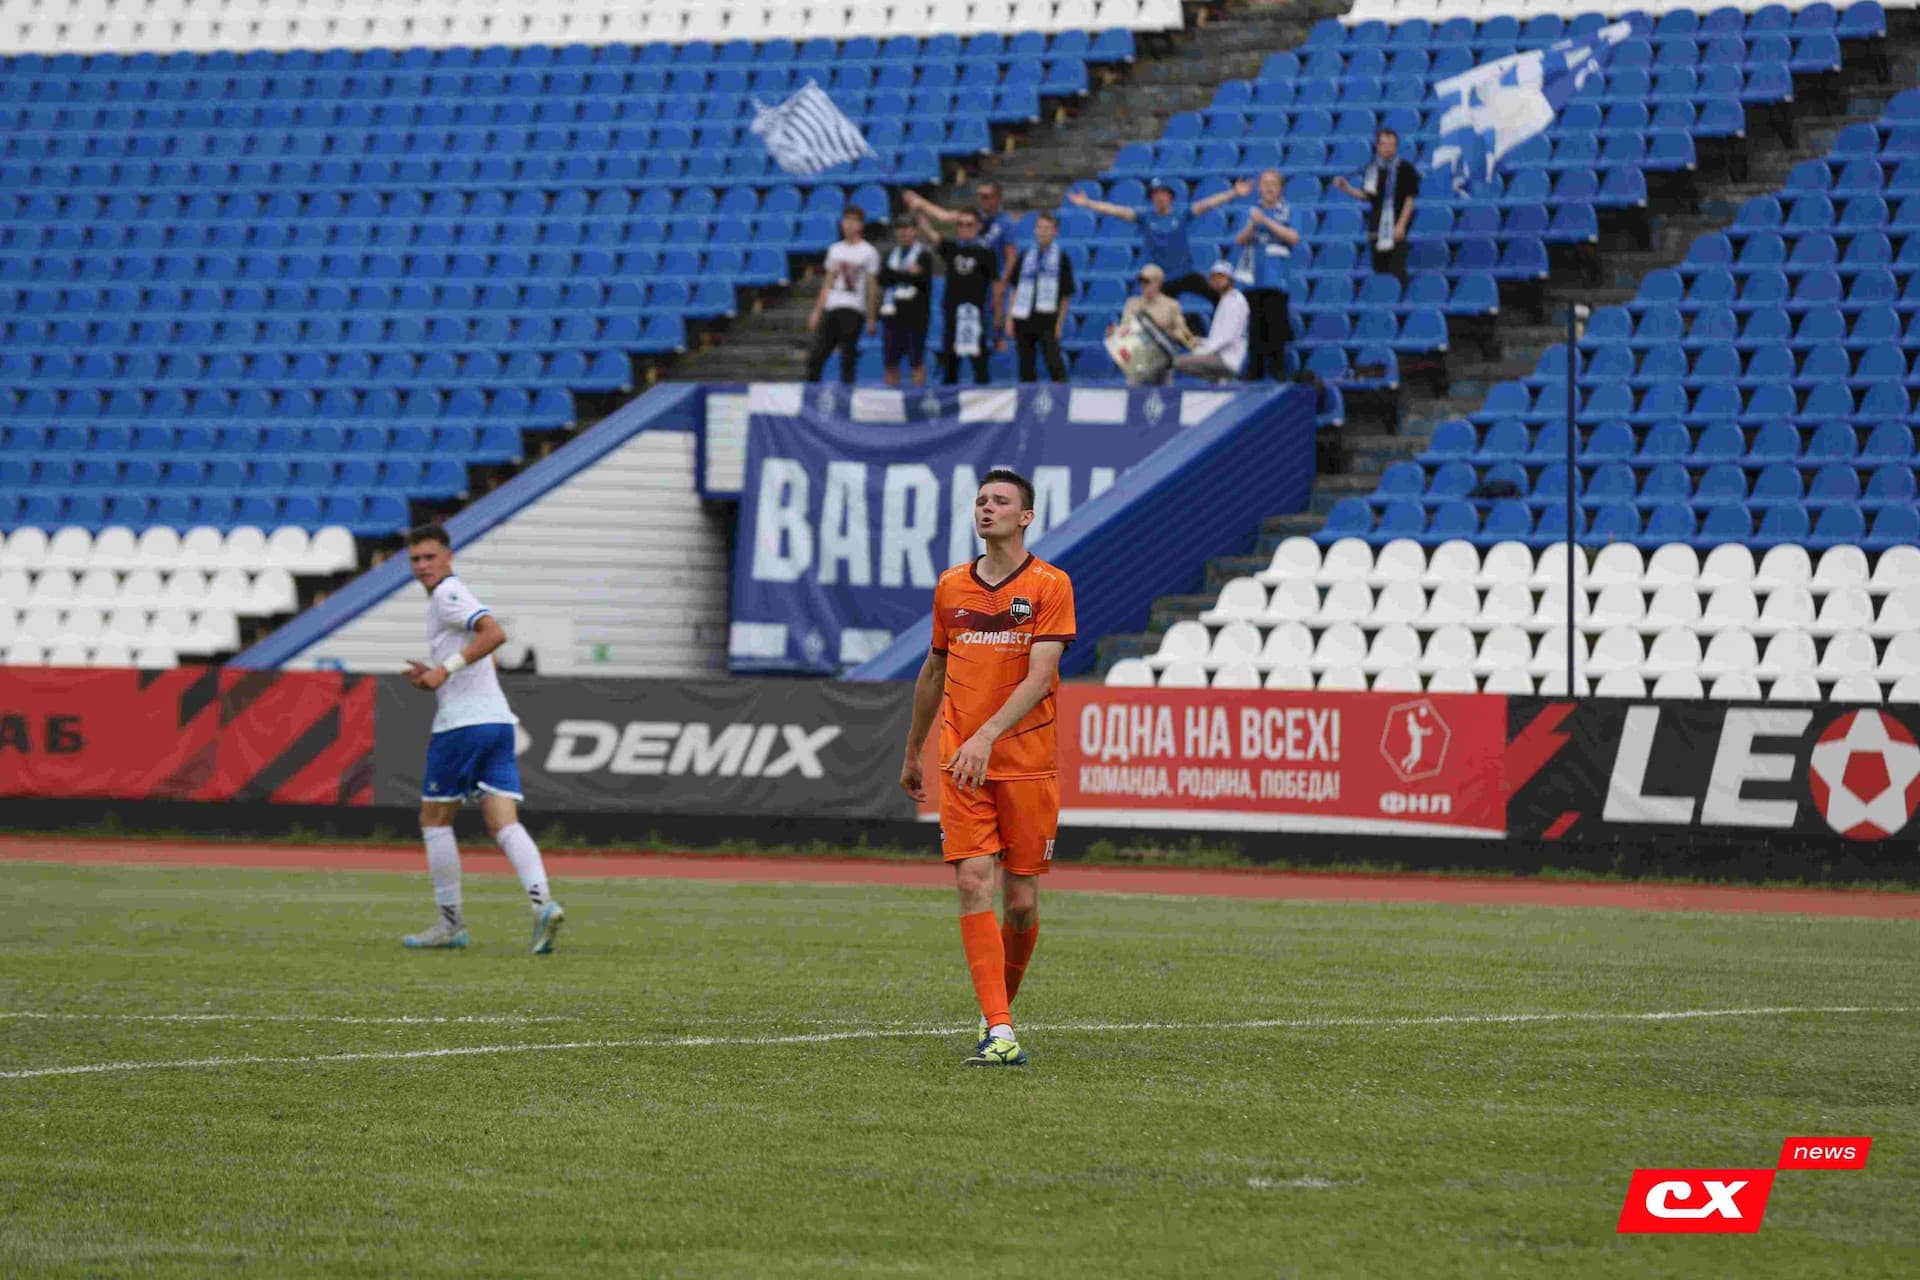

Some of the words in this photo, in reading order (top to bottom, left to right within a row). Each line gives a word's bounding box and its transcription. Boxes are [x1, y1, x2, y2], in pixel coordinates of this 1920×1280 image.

[544, 719, 842, 778] DEMIX
[1080, 703, 1176, 762] ОДНА
[1185, 706, 1231, 759] НА
[1240, 708, 1341, 761] ВСЕХ!
[1079, 766, 1174, 797] КОМАНДА,
[1177, 767, 1257, 800] РОДИНА,
[1260, 770, 1341, 801] ПОБЕДА!
[1379, 791, 1452, 815] ФНЛ
